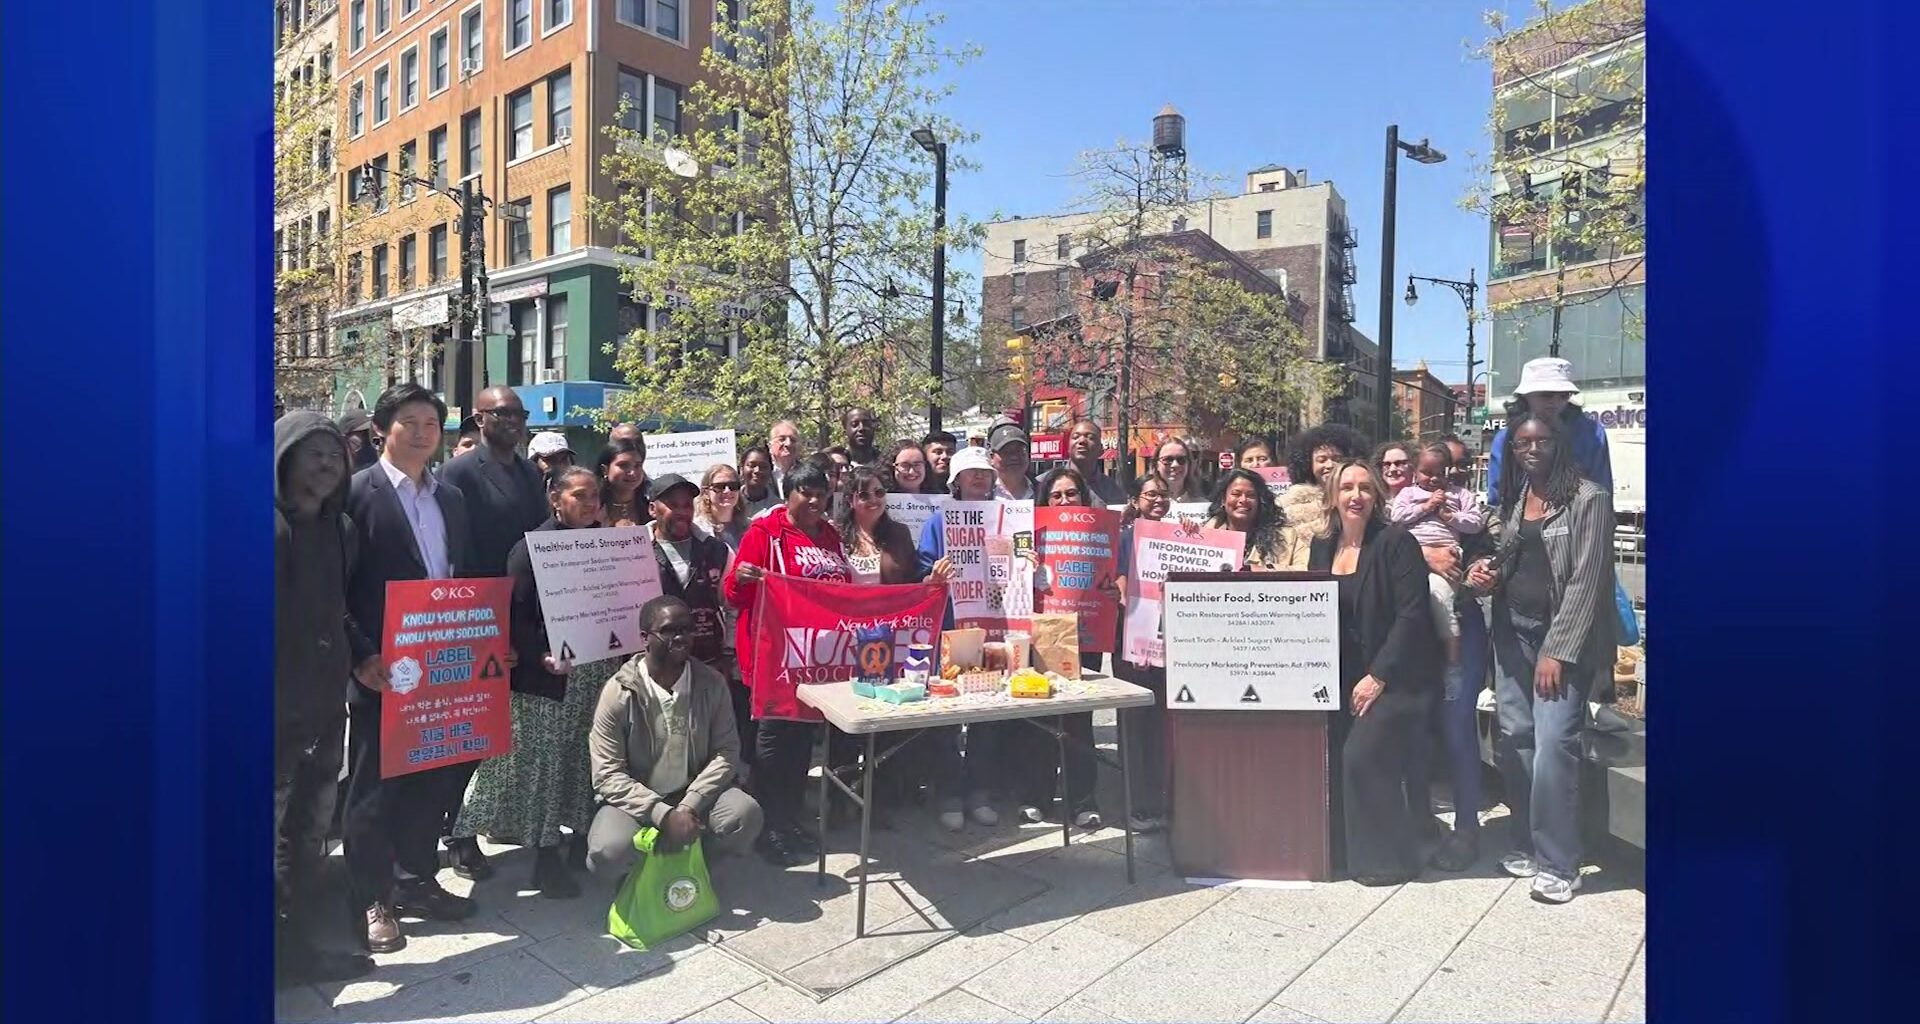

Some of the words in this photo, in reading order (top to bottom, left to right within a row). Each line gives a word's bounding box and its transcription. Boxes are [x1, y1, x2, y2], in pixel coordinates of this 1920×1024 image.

[680, 439, 713, 448] Stronger
[885, 503, 905, 511] ood,
[906, 502, 940, 512] Stronge
[945, 511, 960, 525] SEE
[963, 511, 984, 525] THE
[1072, 513, 1096, 523] KCS
[946, 528, 985, 546] SUGAR
[1018, 537, 1028, 548] 16
[534, 542, 573, 553] Healthier
[575, 540, 598, 550] Food,
[599, 538, 631, 549] Stronger
[1148, 541, 1224, 558] INFORMATION
[1158, 552, 1168, 561] IS
[1169, 554, 1211, 567] POWER.
[1055, 560, 1096, 574] LABEL
[448, 586, 476, 599] KCS
[1171, 592, 1222, 603] Healthier
[1224, 592, 1254, 603] Food,
[1258, 592, 1307, 604] Stronger
[1309, 592, 1329, 602] NY!
[402, 611, 436, 627] KNOW
[437, 609, 467, 623] YOUR
[1176, 610, 1198, 618] Chain
[1240, 610, 1268, 618] Sodium
[1268, 611, 1301, 620] Warning
[1301, 610, 1326, 618] Labels
[836, 619, 872, 632] New
[901, 614, 933, 629] State
[395, 630, 426, 646] KNOW
[427, 628, 456, 642] YOUR
[1247, 636, 1273, 645] Sugars
[1274, 637, 1305, 645] Warning
[425, 646, 476, 666] LABEL
[1174, 661, 1209, 669] Predatory
[1211, 661, 1248, 670] Marketing
[1250, 661, 1289, 669] Prevention
[1290, 661, 1302, 669] Act
[428, 664, 473, 685] NOW!
